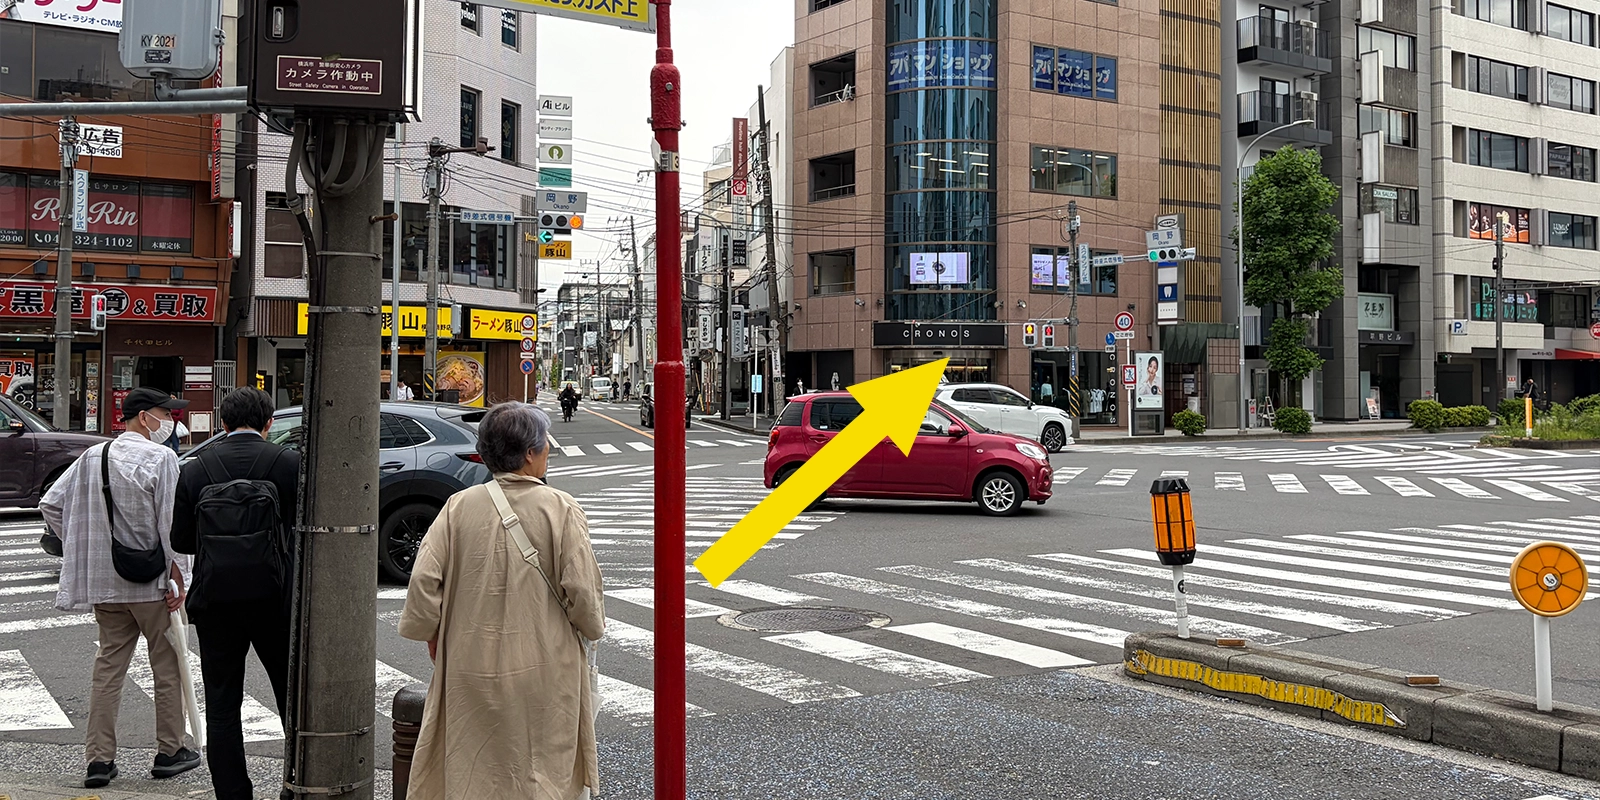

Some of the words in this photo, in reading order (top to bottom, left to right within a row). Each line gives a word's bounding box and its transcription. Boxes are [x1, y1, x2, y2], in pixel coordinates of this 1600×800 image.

[141, 35, 152, 47] KY
[154, 35, 175, 47] 2021
[889, 53, 993, 76] アパマンショップ
[285, 67, 373, 82] カメラ作動中
[542, 99, 552, 110] Ai
[76, 172, 85, 229] スクランブル式
[546, 193, 577, 204] 岡野
[87, 201, 138, 226] Rin
[463, 212, 511, 222] 時差式信号機
[152, 242, 181, 250] 木曜定休
[545, 248, 566, 257] 豚山
[1080, 245, 1088, 282] スクランブル式
[524, 318, 532, 327] 30
[1119, 317, 1130, 326] 40
[1453, 322, 1462, 332] P
[903, 330, 970, 338] CRONOS
